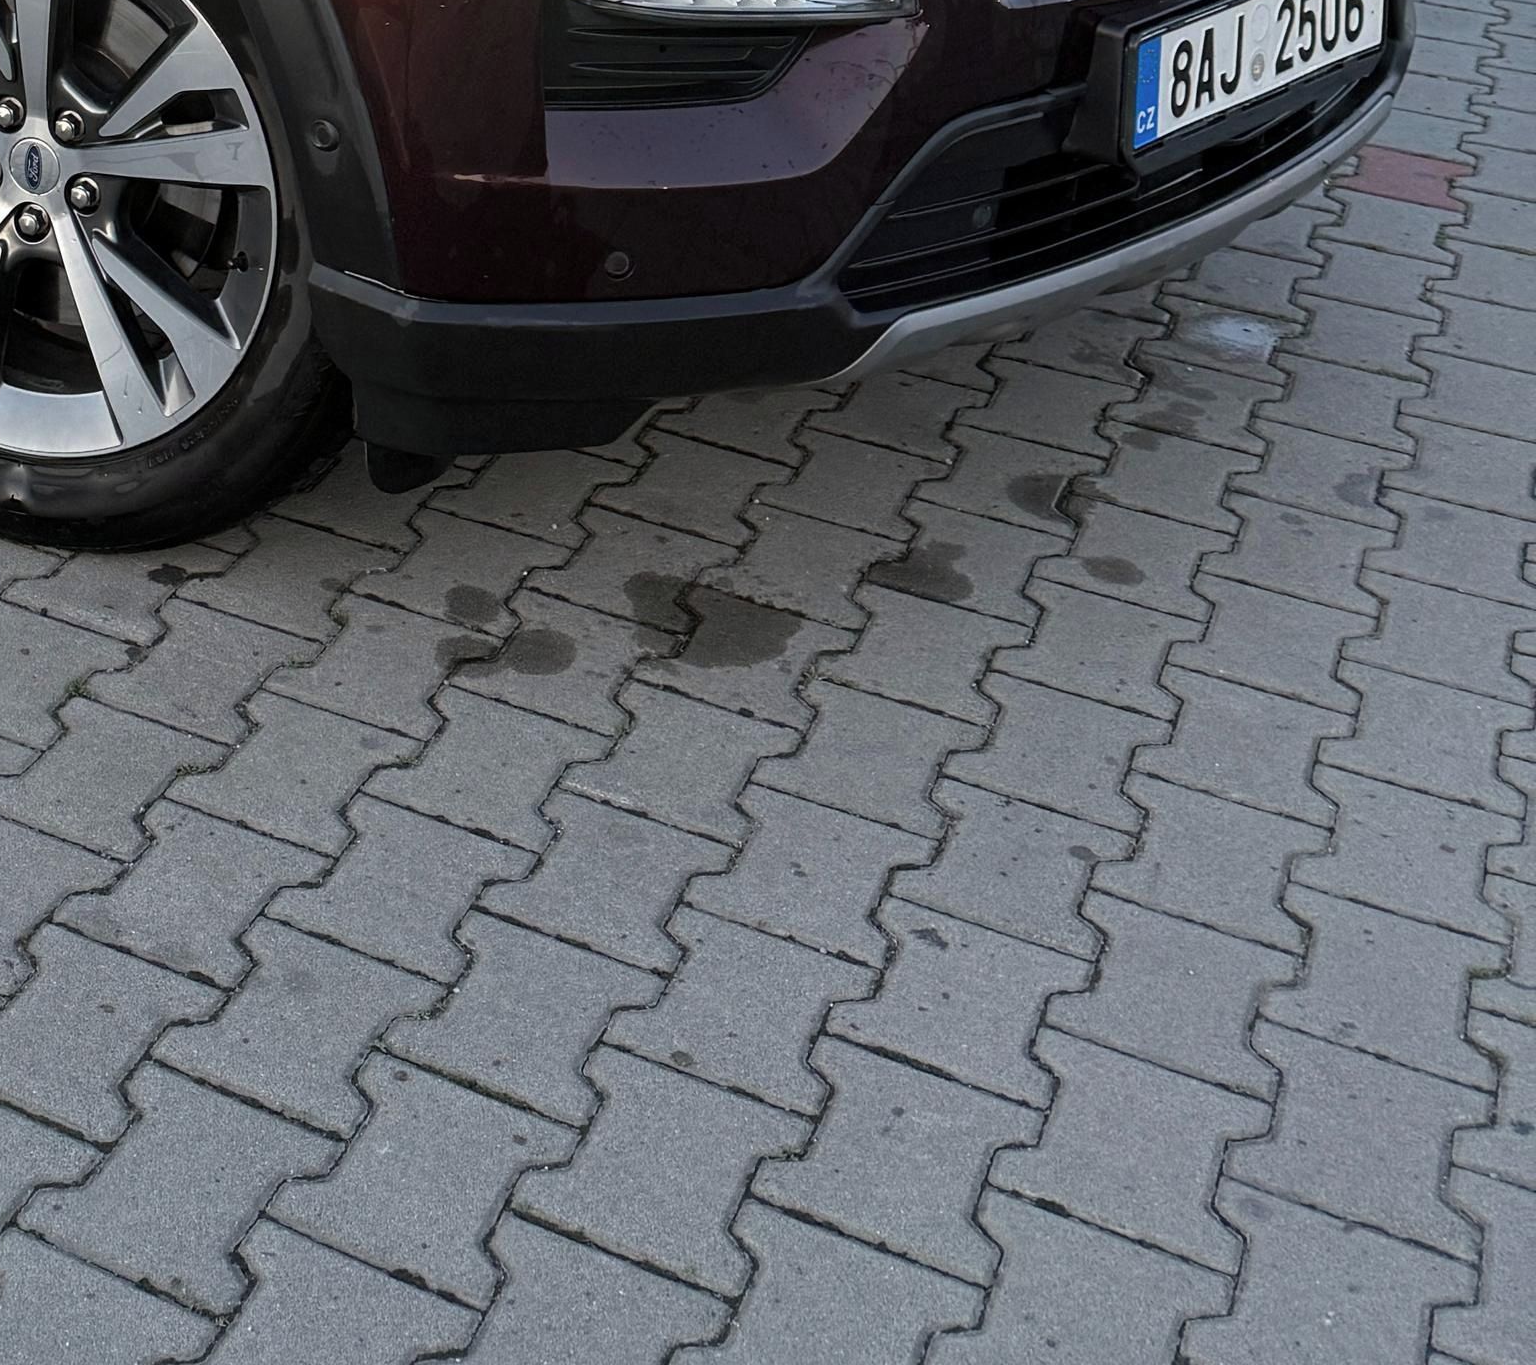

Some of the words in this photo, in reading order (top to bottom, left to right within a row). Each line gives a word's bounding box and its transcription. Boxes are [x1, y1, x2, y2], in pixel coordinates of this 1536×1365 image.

[1170, 14, 1246, 119] 8AJ
[1135, 105, 1156, 135] CZ
[27, 151, 41, 183] Ford
